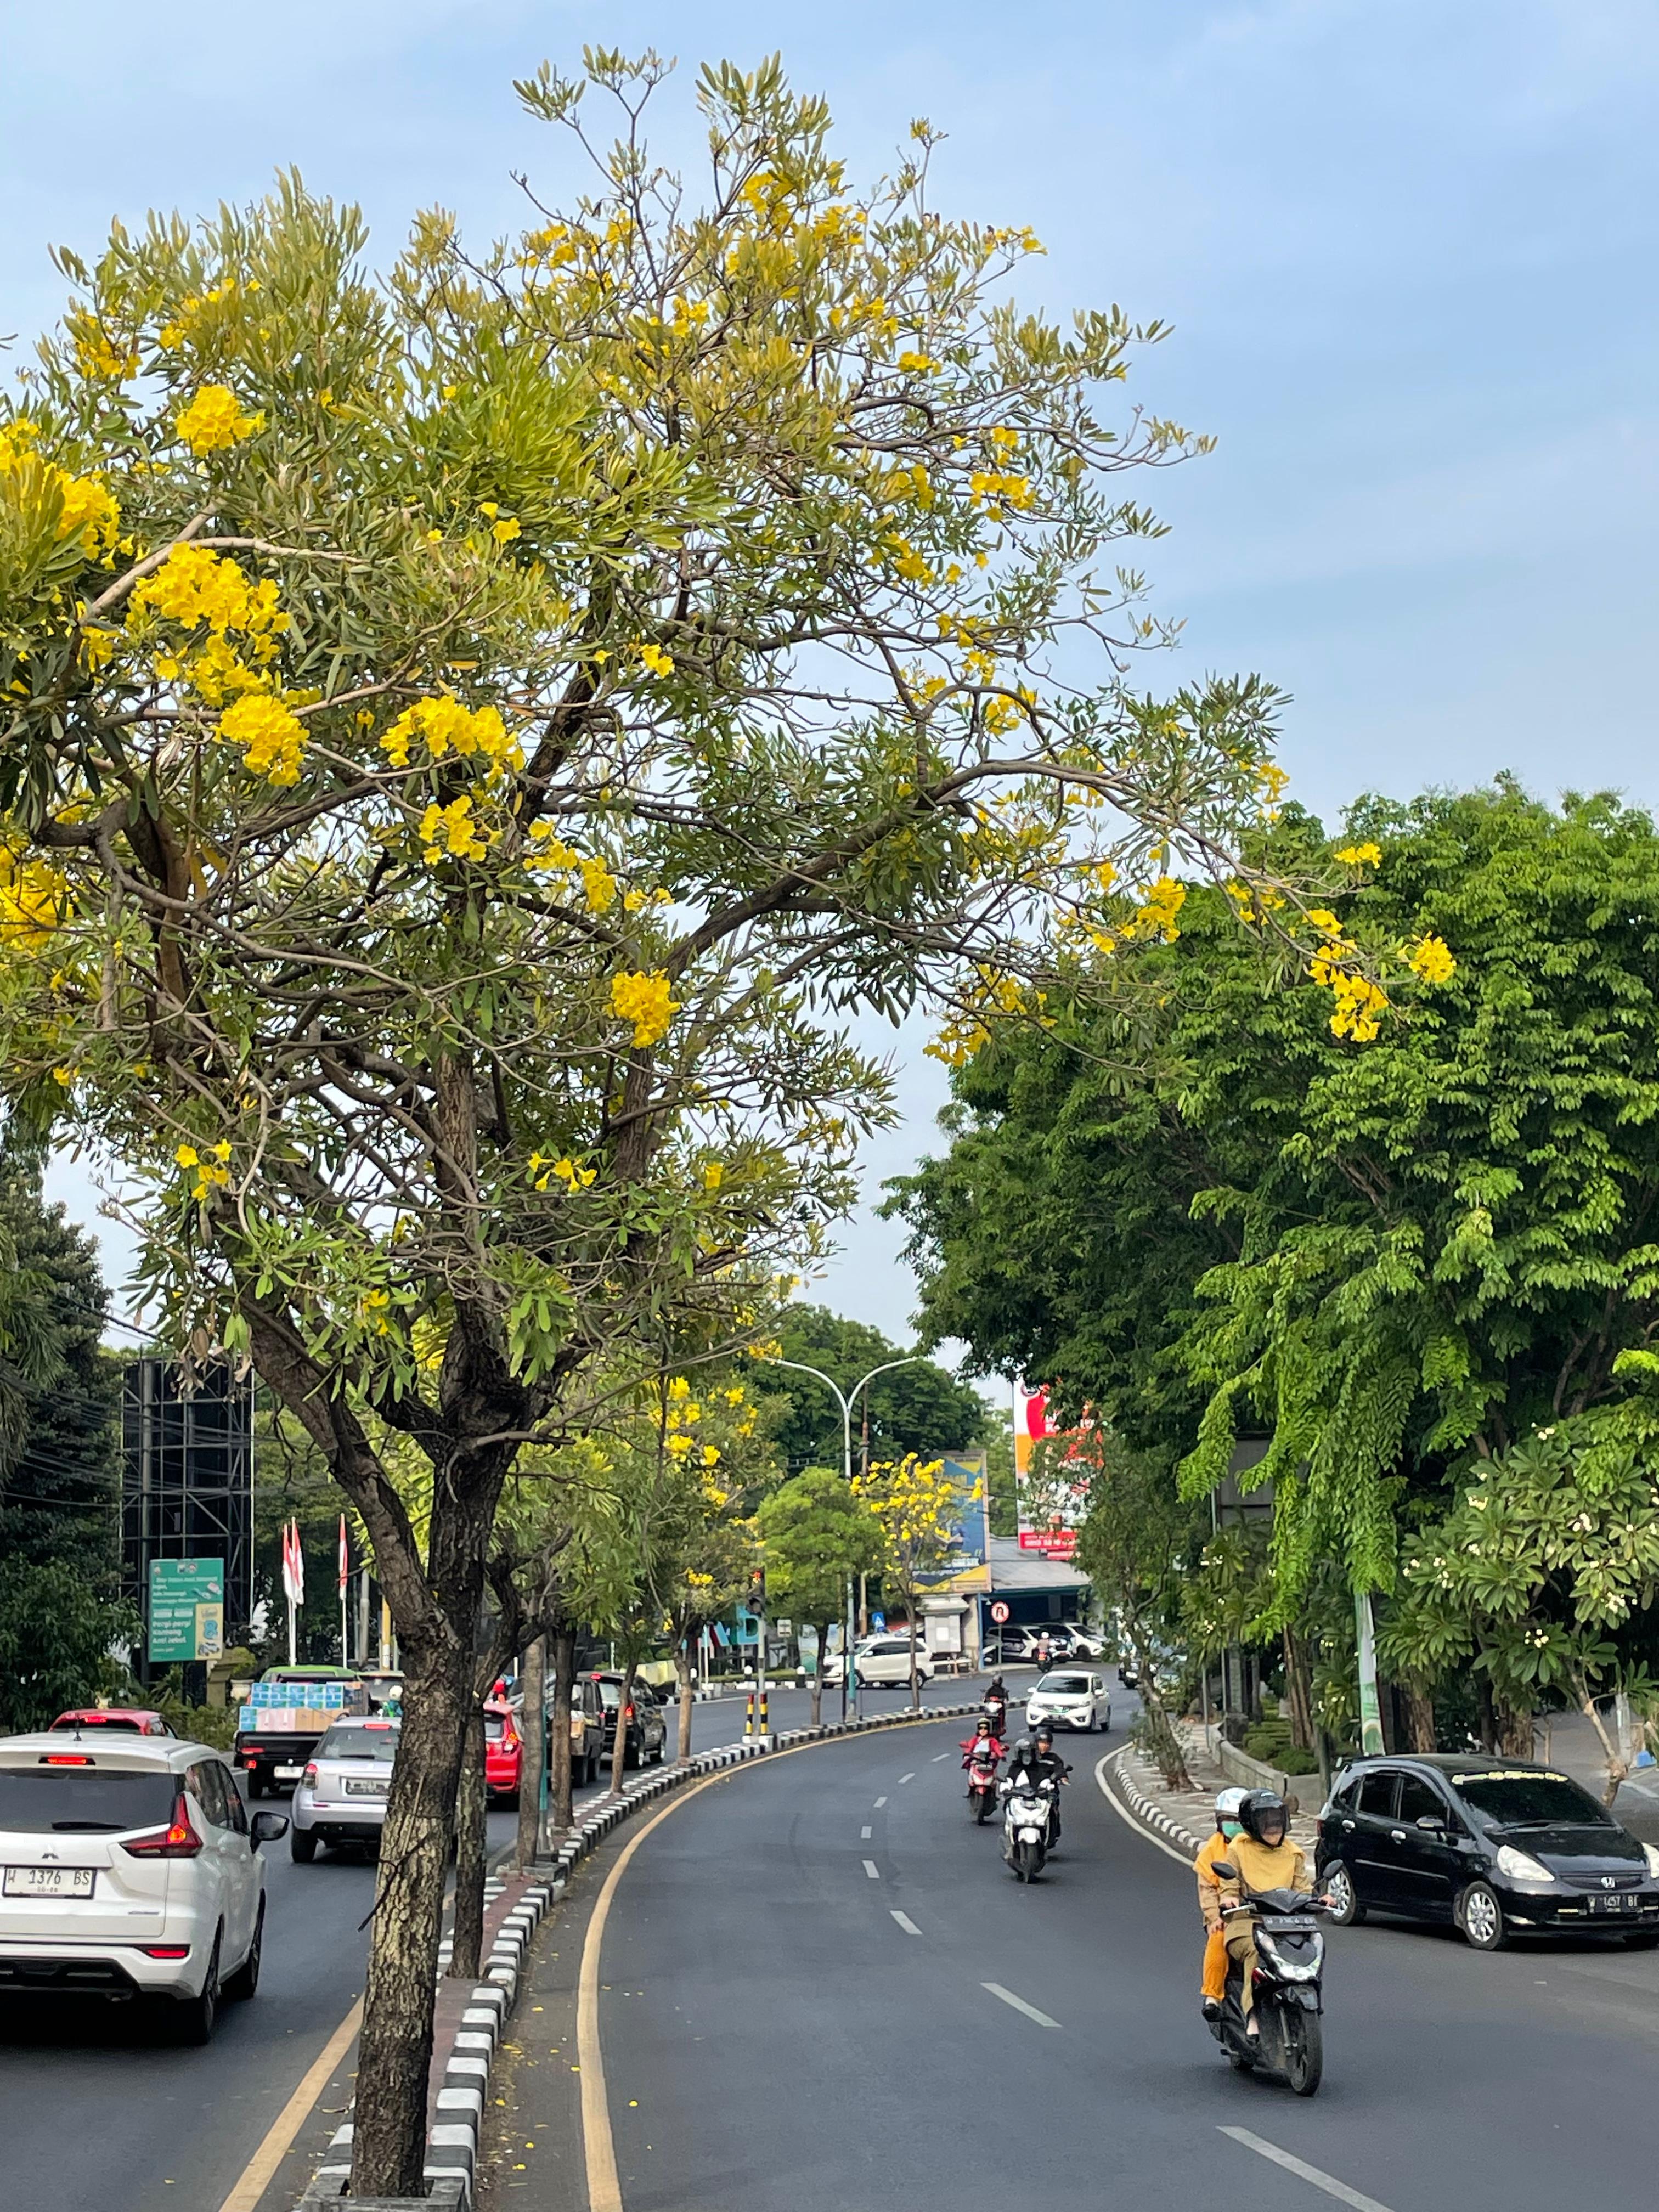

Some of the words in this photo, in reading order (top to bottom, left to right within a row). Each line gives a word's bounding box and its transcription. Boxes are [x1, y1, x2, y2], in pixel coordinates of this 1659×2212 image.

[8, 1869, 16, 1883] W
[28, 1869, 61, 1885] 1376
[74, 1870, 91, 1886] BS
